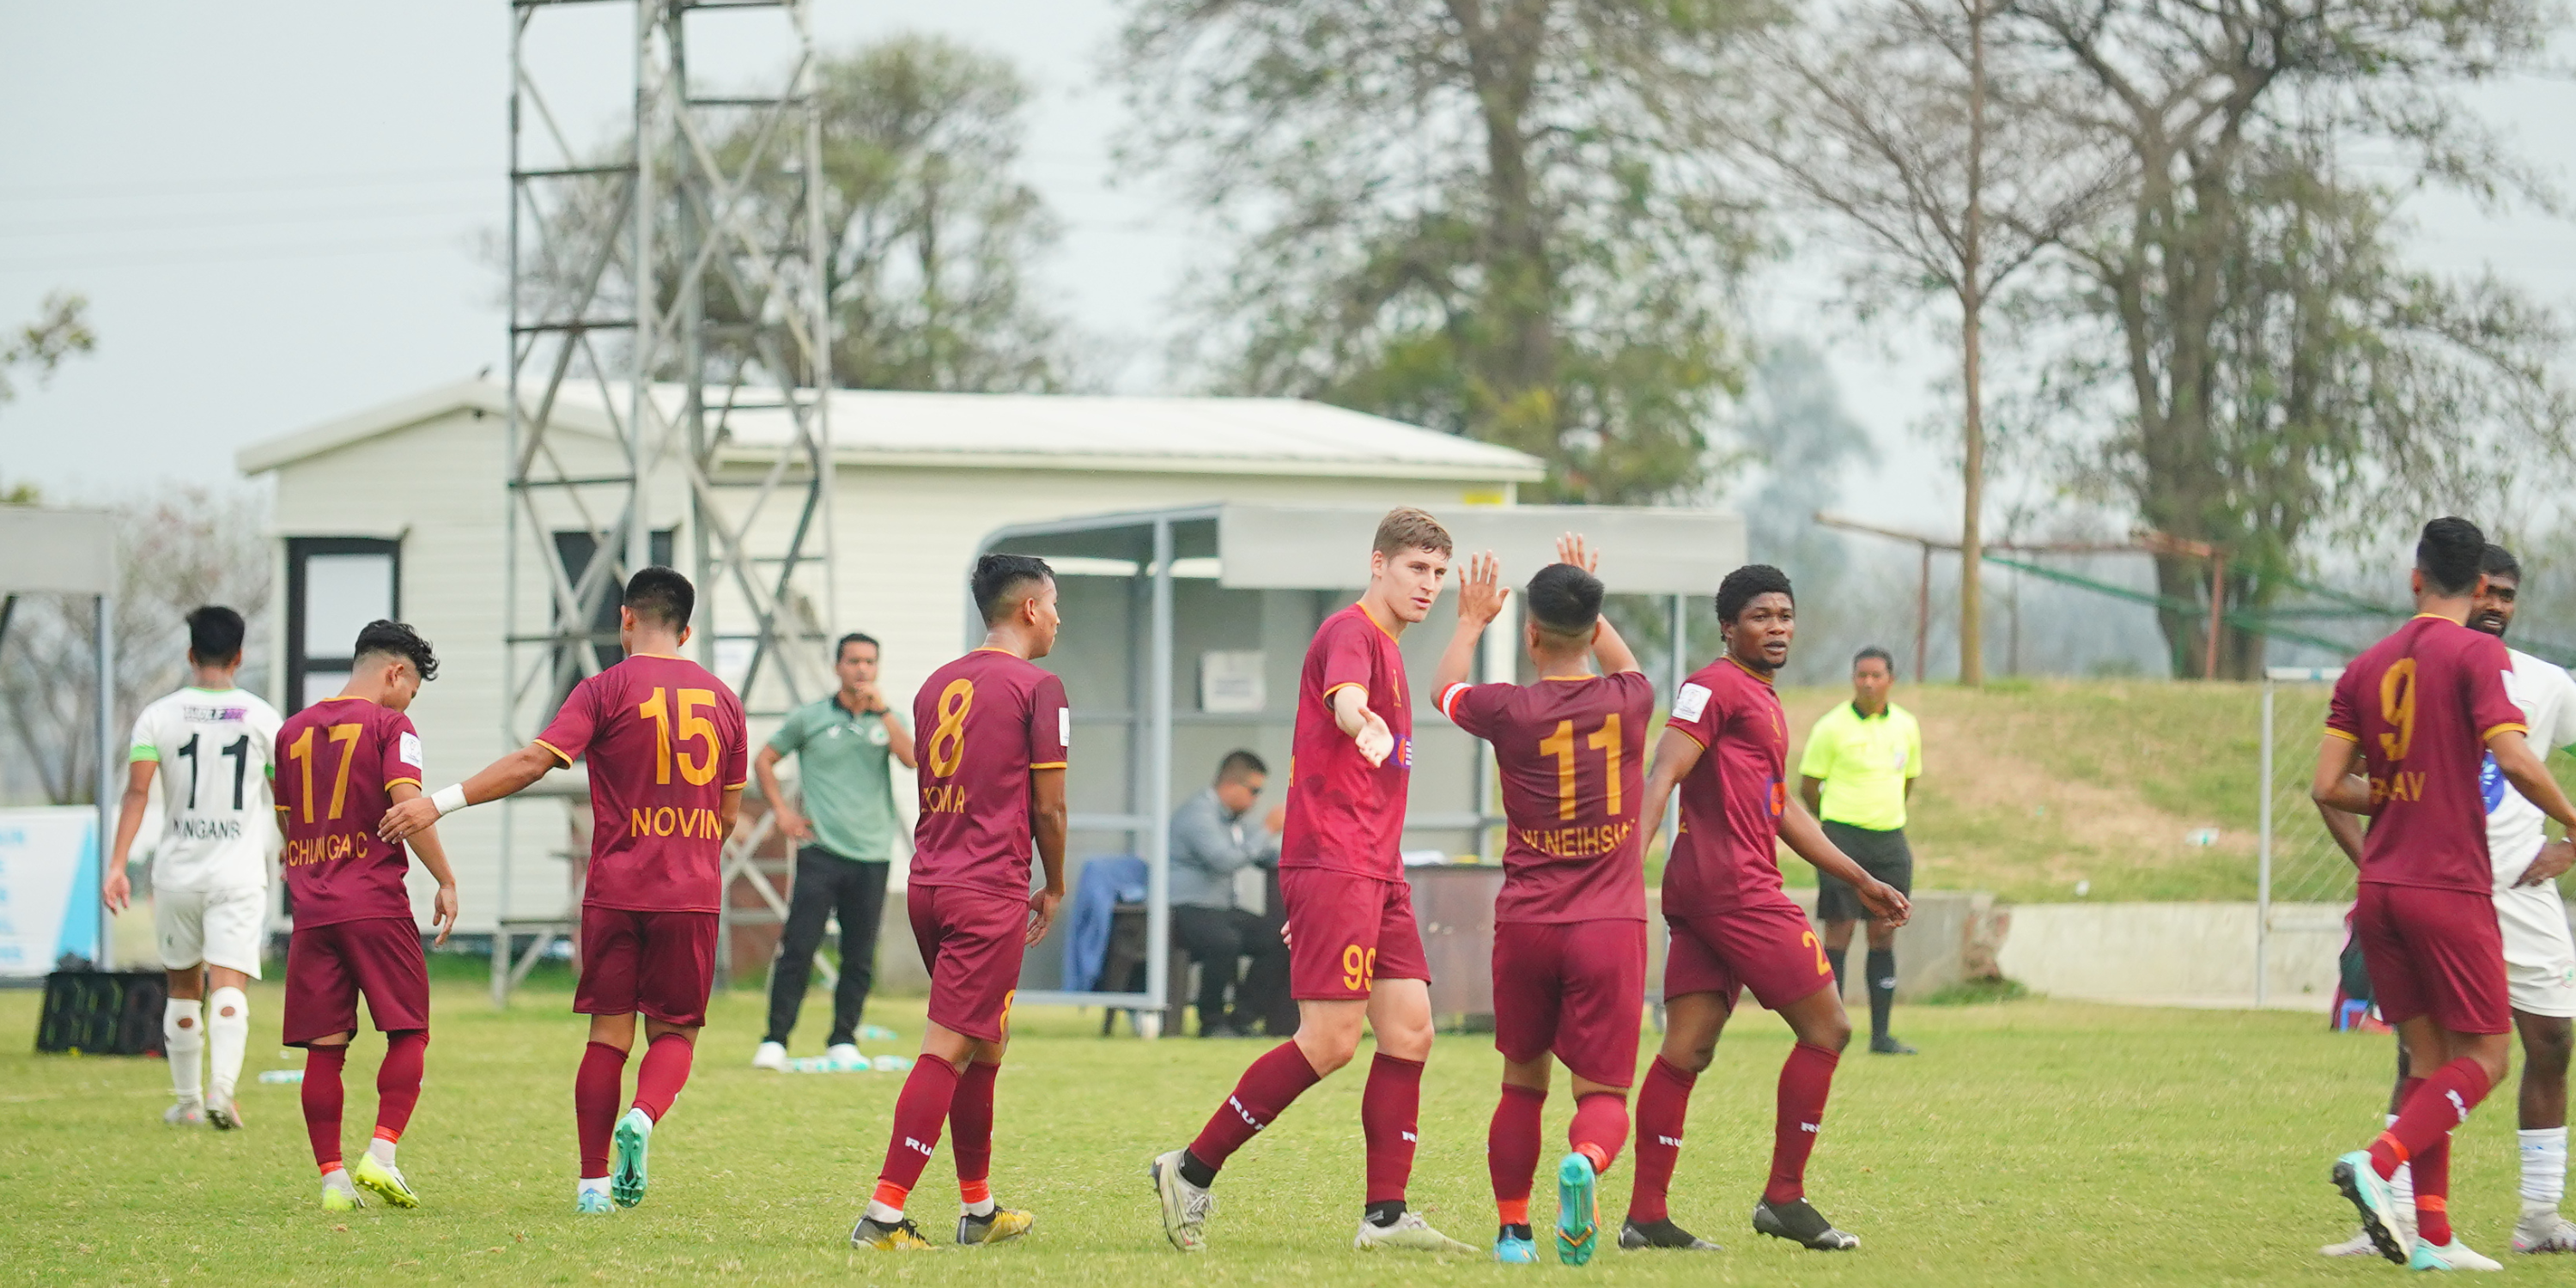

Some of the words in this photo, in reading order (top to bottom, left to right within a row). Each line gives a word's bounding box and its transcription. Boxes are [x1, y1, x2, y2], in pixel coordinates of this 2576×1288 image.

[639, 687, 720, 786] 15
[929, 678, 974, 778] 8
[2379, 657, 2416, 762] 9
[179, 733, 248, 810] 11
[290, 723, 363, 823] 17
[1540, 713, 1622, 821] 11
[630, 806, 722, 840] NOVIN
[1343, 945, 1376, 992] 99
